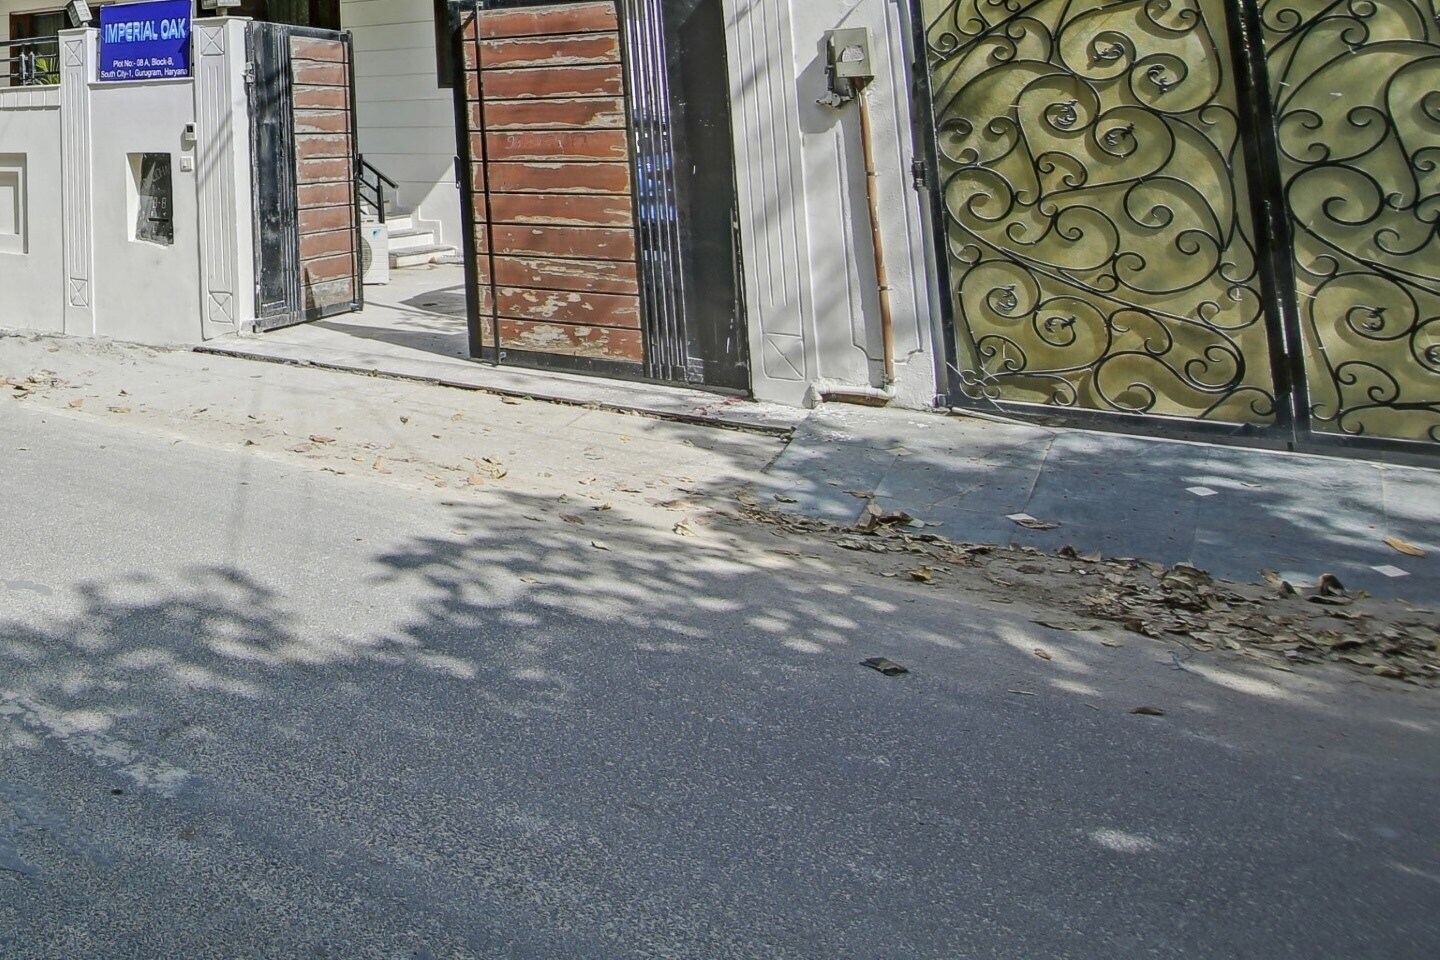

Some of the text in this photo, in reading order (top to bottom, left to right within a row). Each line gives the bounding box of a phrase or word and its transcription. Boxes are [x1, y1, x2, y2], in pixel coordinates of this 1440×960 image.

[104, 17, 186, 44] IMPERIAL OAK
[113, 59, 124, 68] Plot
[100, 70, 115, 78] South
[164, 67, 187, 77] Haryana
